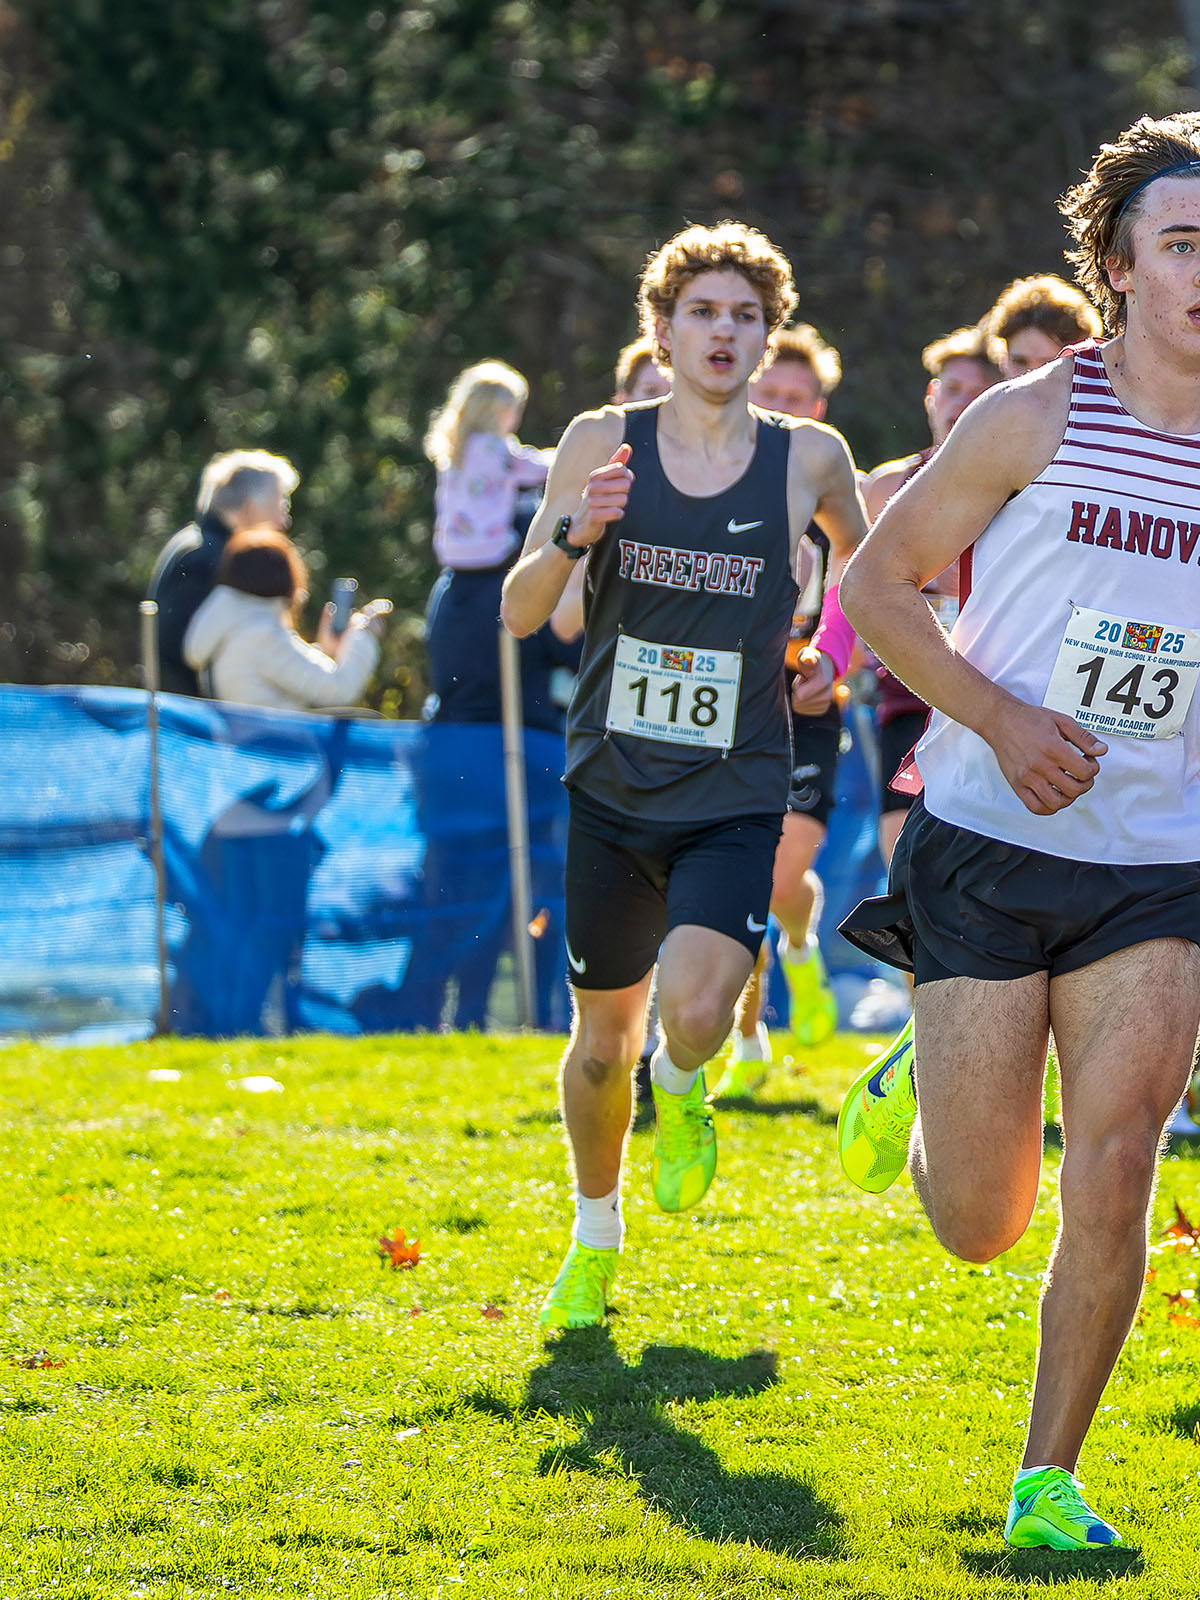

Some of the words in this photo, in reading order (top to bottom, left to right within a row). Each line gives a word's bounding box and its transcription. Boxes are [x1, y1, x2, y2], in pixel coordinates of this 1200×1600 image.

[618, 539, 765, 599] FREEPORT
[1064, 637, 1080, 647] NEW
[1080, 641, 1109, 655] ENGLAND
[1109, 648, 1124, 658] HIGH
[1124, 651, 1146, 662] SCHOOL
[1147, 655, 1158, 663] X-C
[1158, 657, 1200, 669] CHAMPIONSHIPS
[1094, 620, 1122, 643] 20
[1160, 632, 1186, 654] 25
[637, 647, 658, 665] 20
[695, 655, 716, 673] 25
[628, 675, 719, 728] 118
[1076, 655, 1180, 720] 143
[1075, 709, 1117, 727] THETFORD
[1117, 718, 1156, 732] ACADEMY
